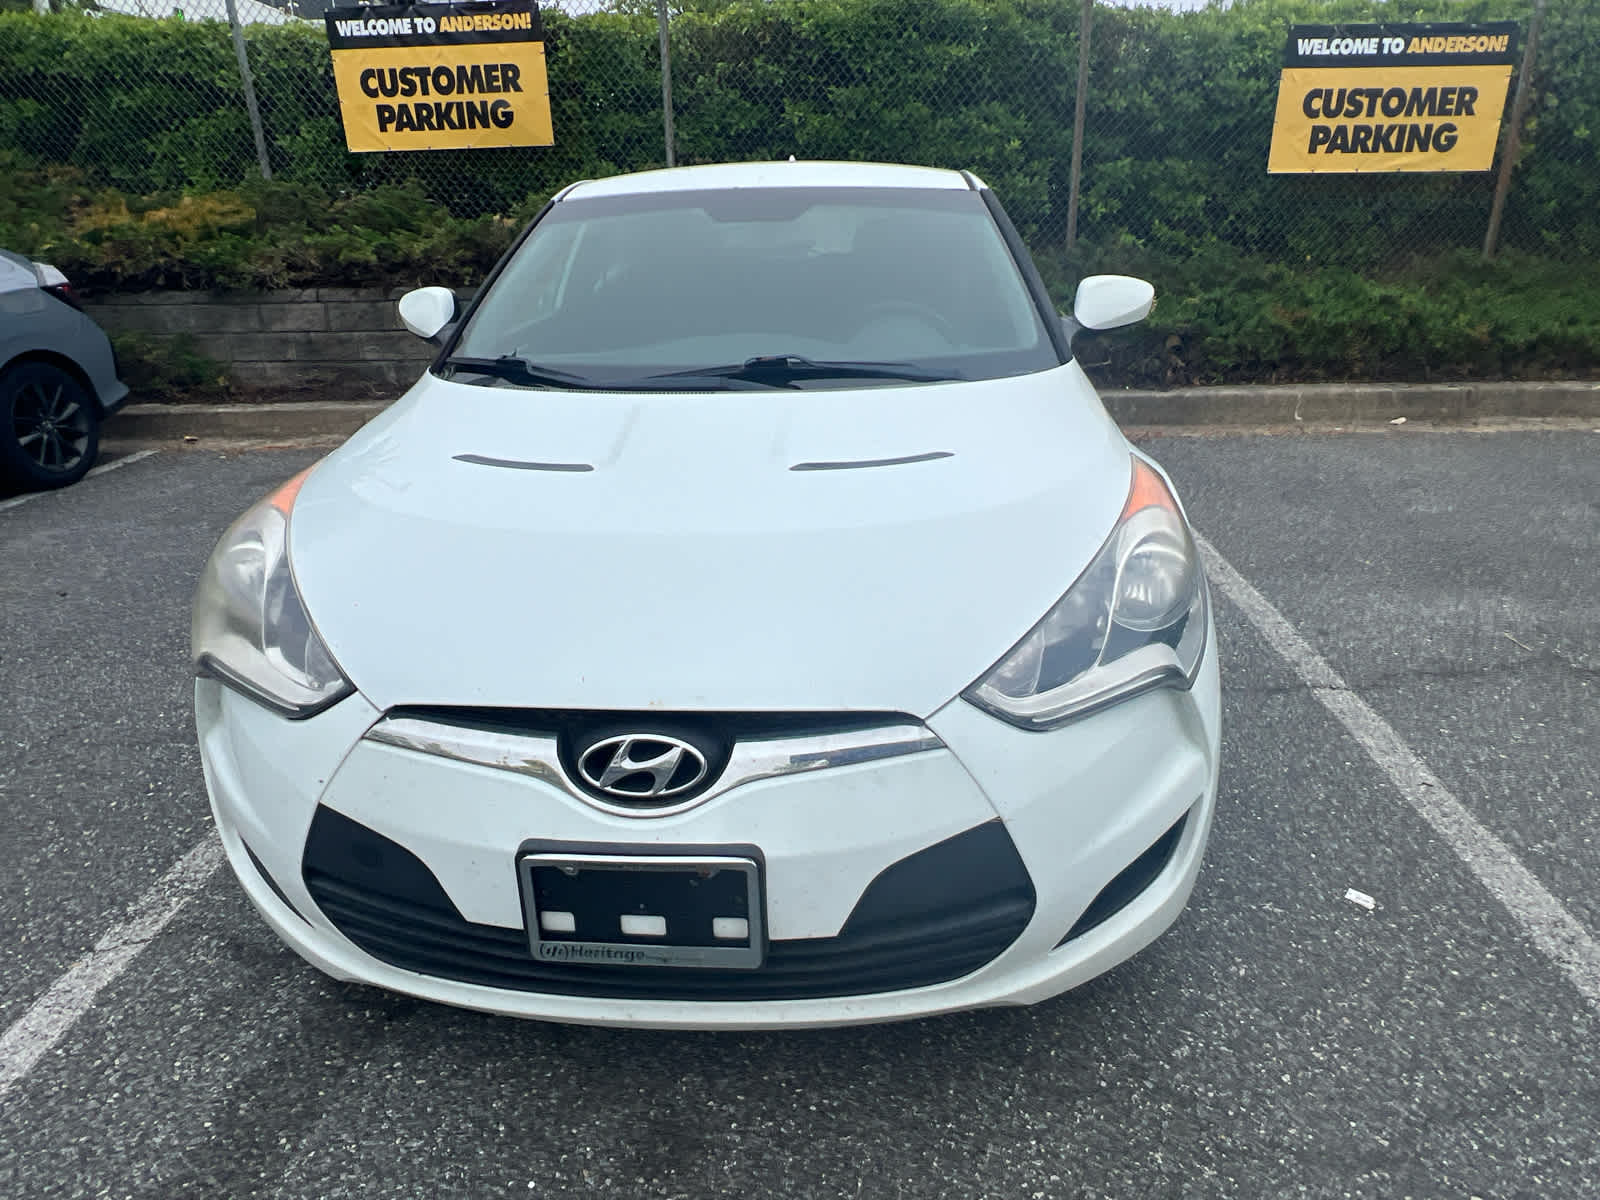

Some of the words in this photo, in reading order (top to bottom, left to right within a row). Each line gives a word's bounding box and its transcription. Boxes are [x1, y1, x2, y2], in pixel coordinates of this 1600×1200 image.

[335, 19, 412, 37] WELCOME
[413, 16, 436, 34] TO
[440, 12, 532, 33] ANDERSON!
[1297, 37, 1379, 55] WELCOME
[1382, 37, 1405, 53] TO
[1407, 34, 1509, 53] ANDERSON!
[360, 63, 523, 98] CUSTOMER
[376, 99, 514, 132] PARKING
[1302, 86, 1479, 119] CUSTOMER
[1307, 123, 1458, 154] PARKING
